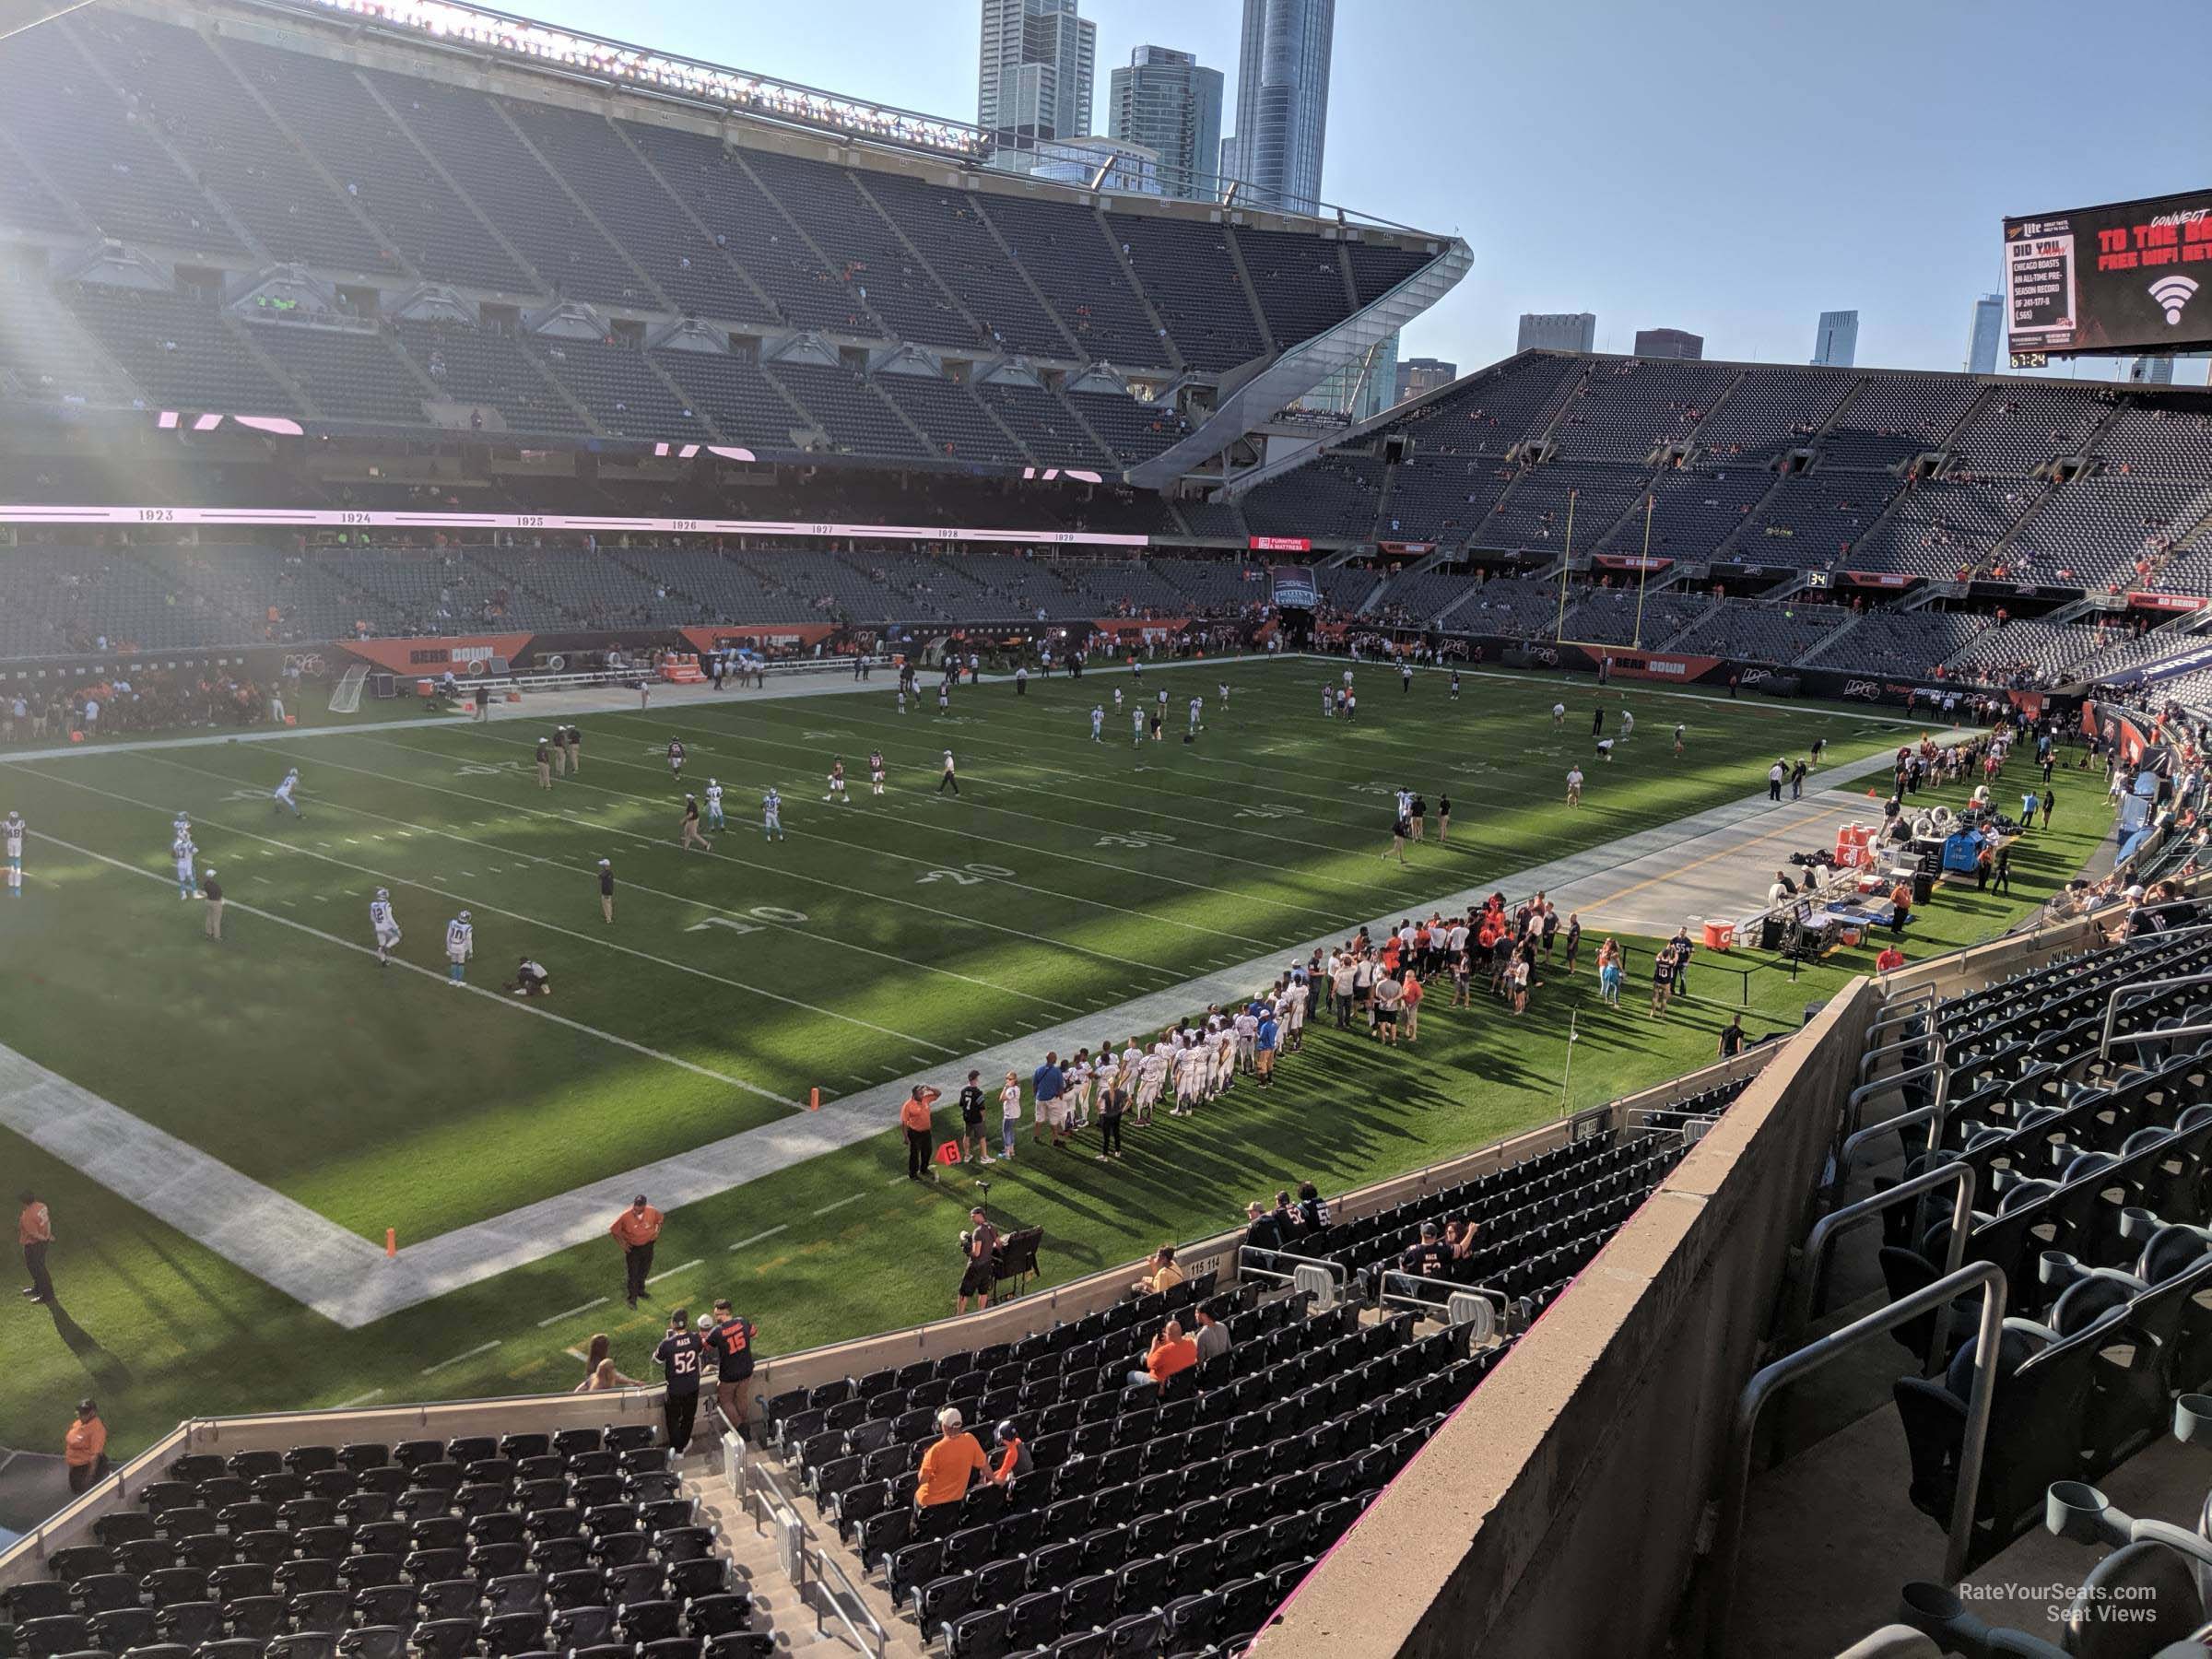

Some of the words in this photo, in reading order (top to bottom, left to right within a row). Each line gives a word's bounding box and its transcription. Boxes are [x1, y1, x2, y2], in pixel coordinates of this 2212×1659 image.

[2151, 209, 2209, 228] CONNECT
[2023, 223, 2041, 237] Lite
[2098, 229, 2126, 252] TO
[2133, 225, 2178, 249] THE
[2013, 243, 2031, 257] DID
[2036, 240, 2059, 254] YOU
[2014, 262, 2037, 271] CHICAGO
[2038, 259, 2060, 268] BOASTS
[2099, 252, 2137, 271] FREE
[2024, 273, 2047, 282] ALL-TIME
[2048, 271, 2063, 280] PRE-
[2015, 286, 2036, 295] SEASON
[2037, 284, 2060, 293] RECORD
[2015, 300, 2023, 308] OF
[139, 510, 173, 521] 1923
[342, 513, 371, 524] 1924
[517, 517, 543, 526] 1925
[673, 521, 697, 530] 1926
[812, 524, 833, 534] 1927
[938, 529, 958, 537] 1928
[1054, 533, 1074, 541] 1929
[1811, 574, 1826, 585] 34
[1615, 656, 1646, 671] BEAR
[1649, 660, 1686, 675] DOWN
[1100, 830, 1177, 849] 30
[925, 864, 1017, 885] 20
[372, 905, 384, 924] 12
[705, 906, 809, 935] 10
[452, 927, 464, 941] 10
[1720, 930, 1731, 944] G
[1676, 943, 1686, 953] 55
[1658, 968, 1668, 978] 10
[965, 1096, 972, 1111] 7
[946, 1145, 958, 1162] G
[1287, 1206, 1305, 1225] 52
[1191, 1264, 1205, 1276] 115
[1207, 1256, 1220, 1268] 114
[677, 1338, 691, 1347] MACK
[726, 1331, 747, 1356] 15
[674, 1351, 696, 1374] 52
